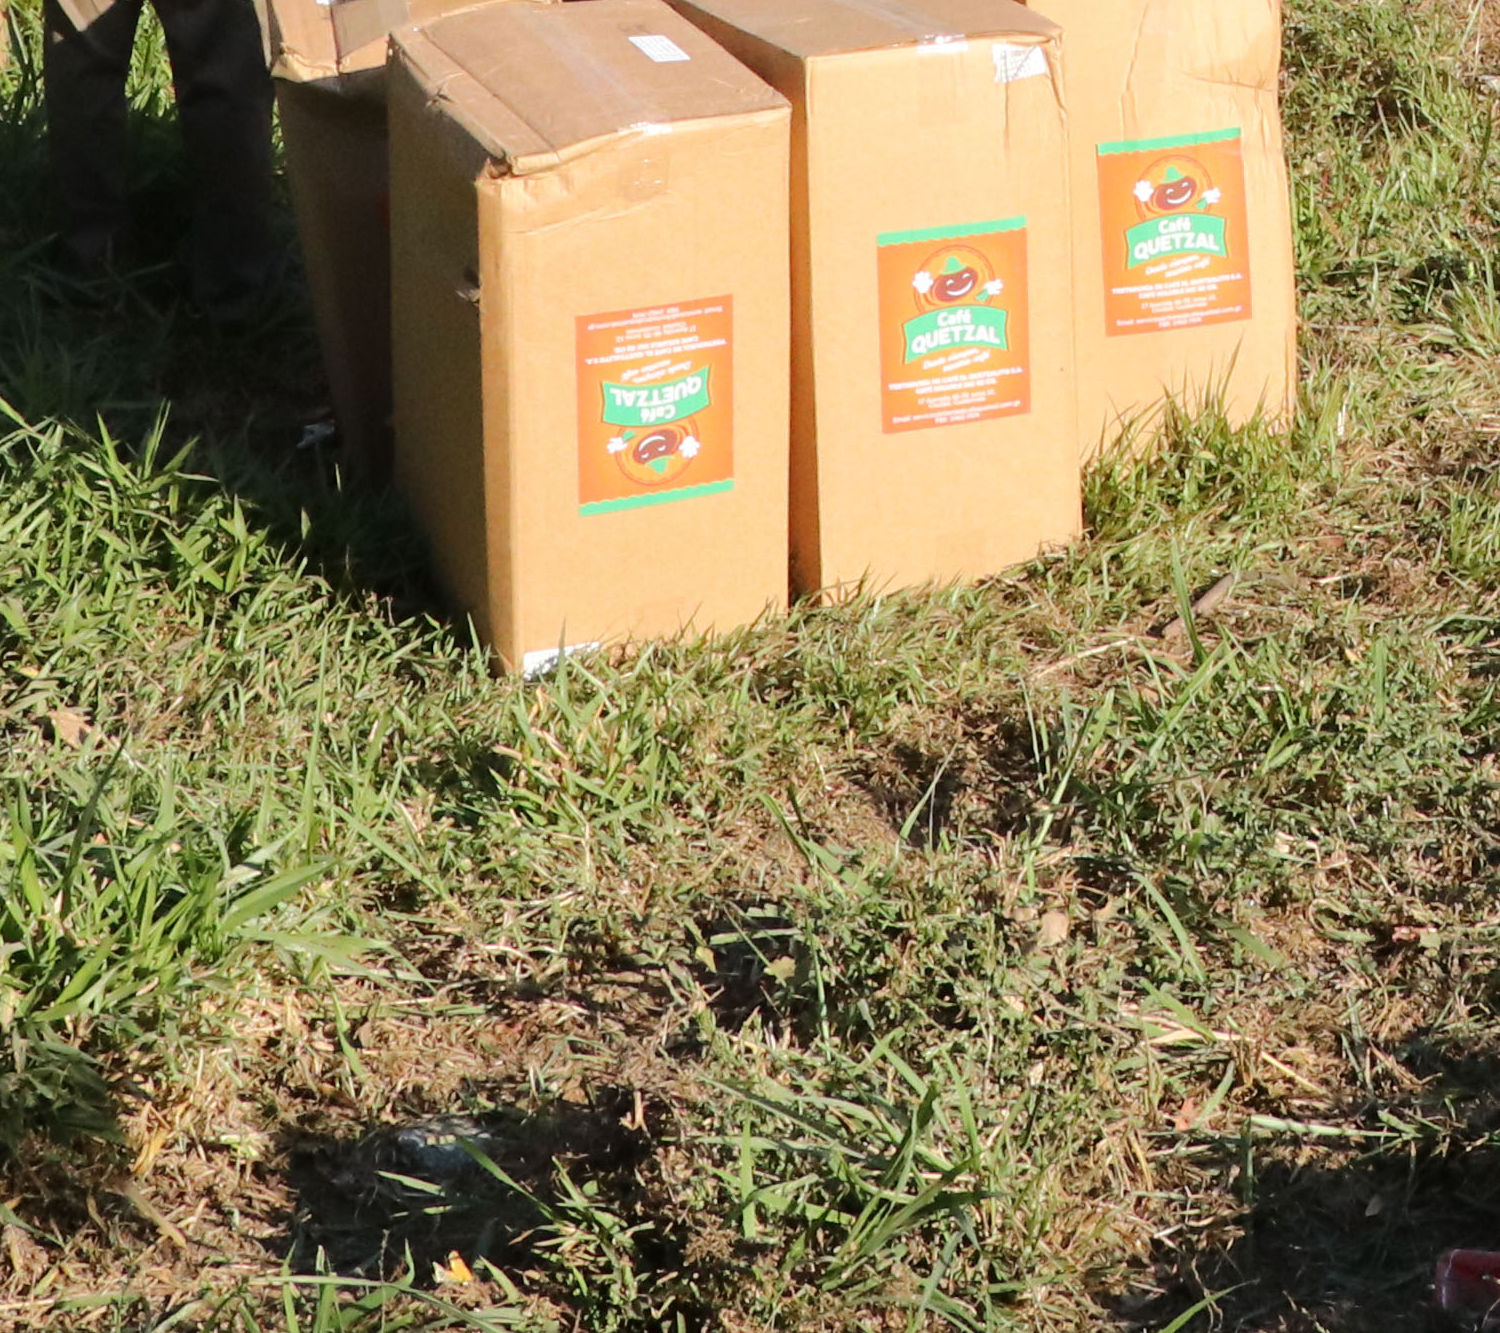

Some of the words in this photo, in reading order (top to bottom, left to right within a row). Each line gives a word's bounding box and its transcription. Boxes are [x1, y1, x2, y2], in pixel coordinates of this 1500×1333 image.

[1158, 216, 1192, 234] Café
[1134, 231, 1220, 259] QUETZAL
[937, 309, 972, 326] Café
[911, 325, 1001, 354] QUETZAL
[609, 375, 702, 407] QUETZAL
[641, 404, 676, 423] Café
